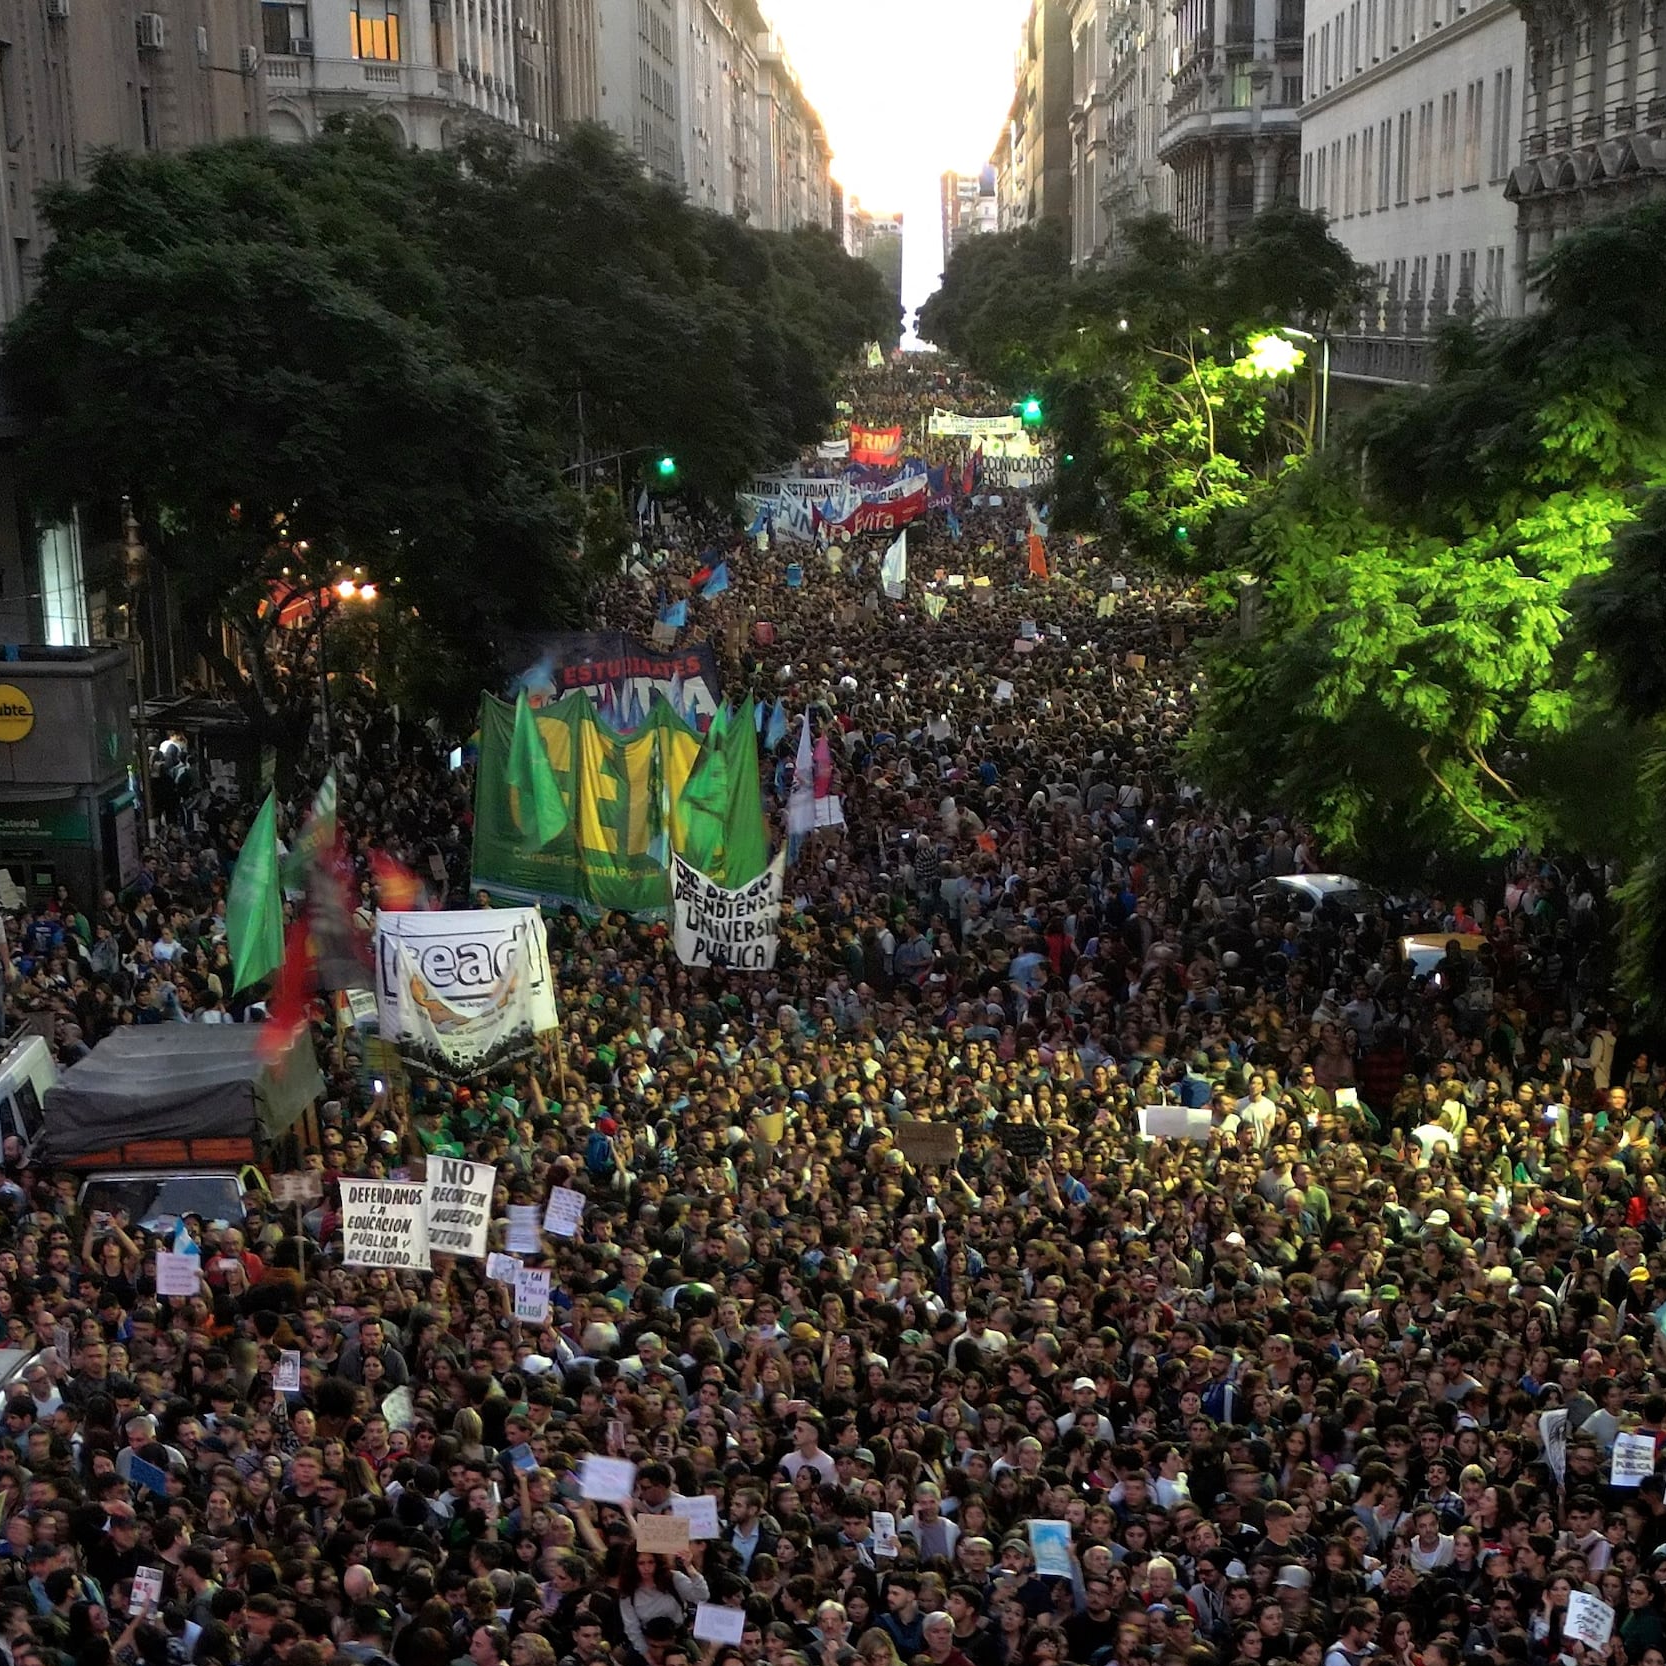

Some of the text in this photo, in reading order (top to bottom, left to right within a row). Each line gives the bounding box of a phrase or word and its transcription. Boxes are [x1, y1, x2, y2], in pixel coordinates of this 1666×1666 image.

[441, 1159, 475, 1185] NO
[348, 1186, 423, 1205] DEFENDAMOS
[433, 1186, 487, 1208] RECORTEN
[369, 1205, 386, 1216] LA
[431, 1208, 482, 1227] NUESTRO
[347, 1216, 413, 1234] EDUCACION
[347, 1249, 362, 1260] DE
